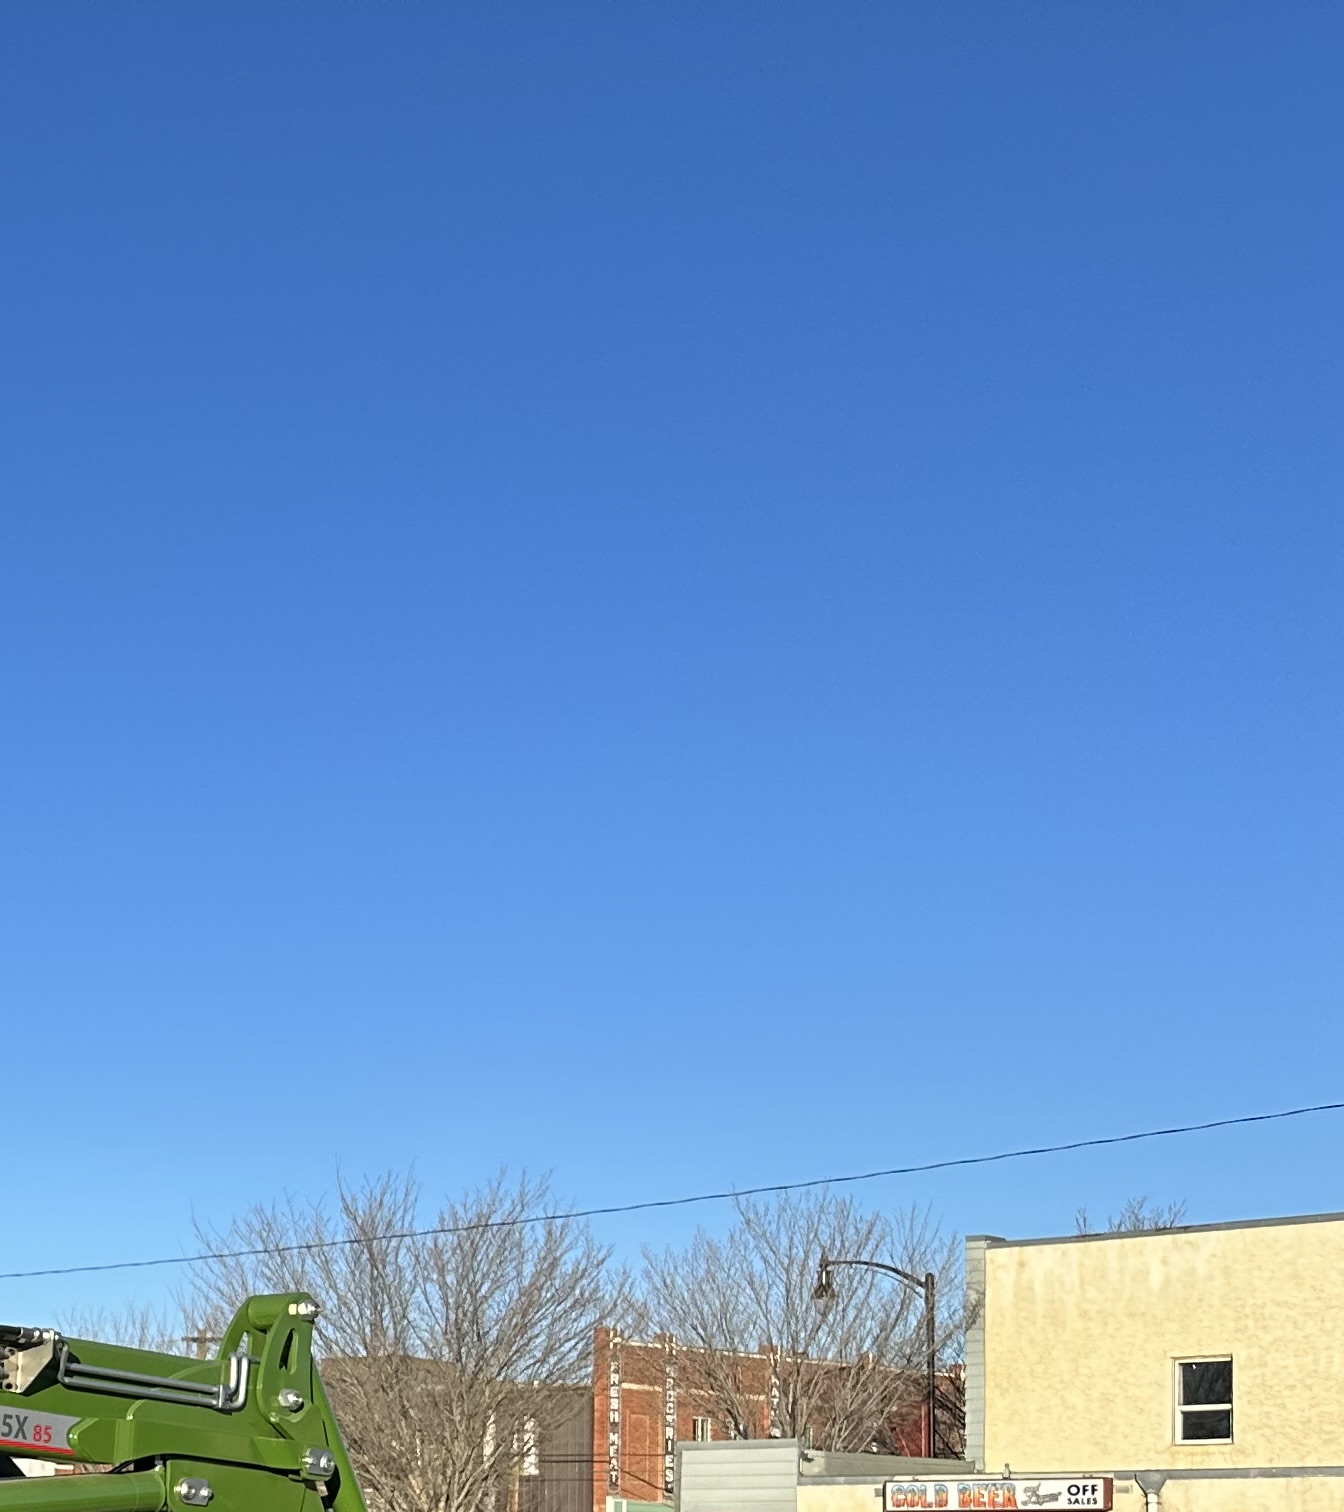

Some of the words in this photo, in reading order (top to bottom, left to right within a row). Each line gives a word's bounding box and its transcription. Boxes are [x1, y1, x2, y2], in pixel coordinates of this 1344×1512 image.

[1, 1413, 29, 1440] 5X
[33, 1424, 52, 1443] 85
[609, 1432, 619, 1484] MEAT
[891, 1483, 949, 1509] COLD
[957, 1482, 1018, 1509] BEER
[1067, 1484, 1098, 1496] OFF
[1067, 1497, 1098, 1505] SALES
